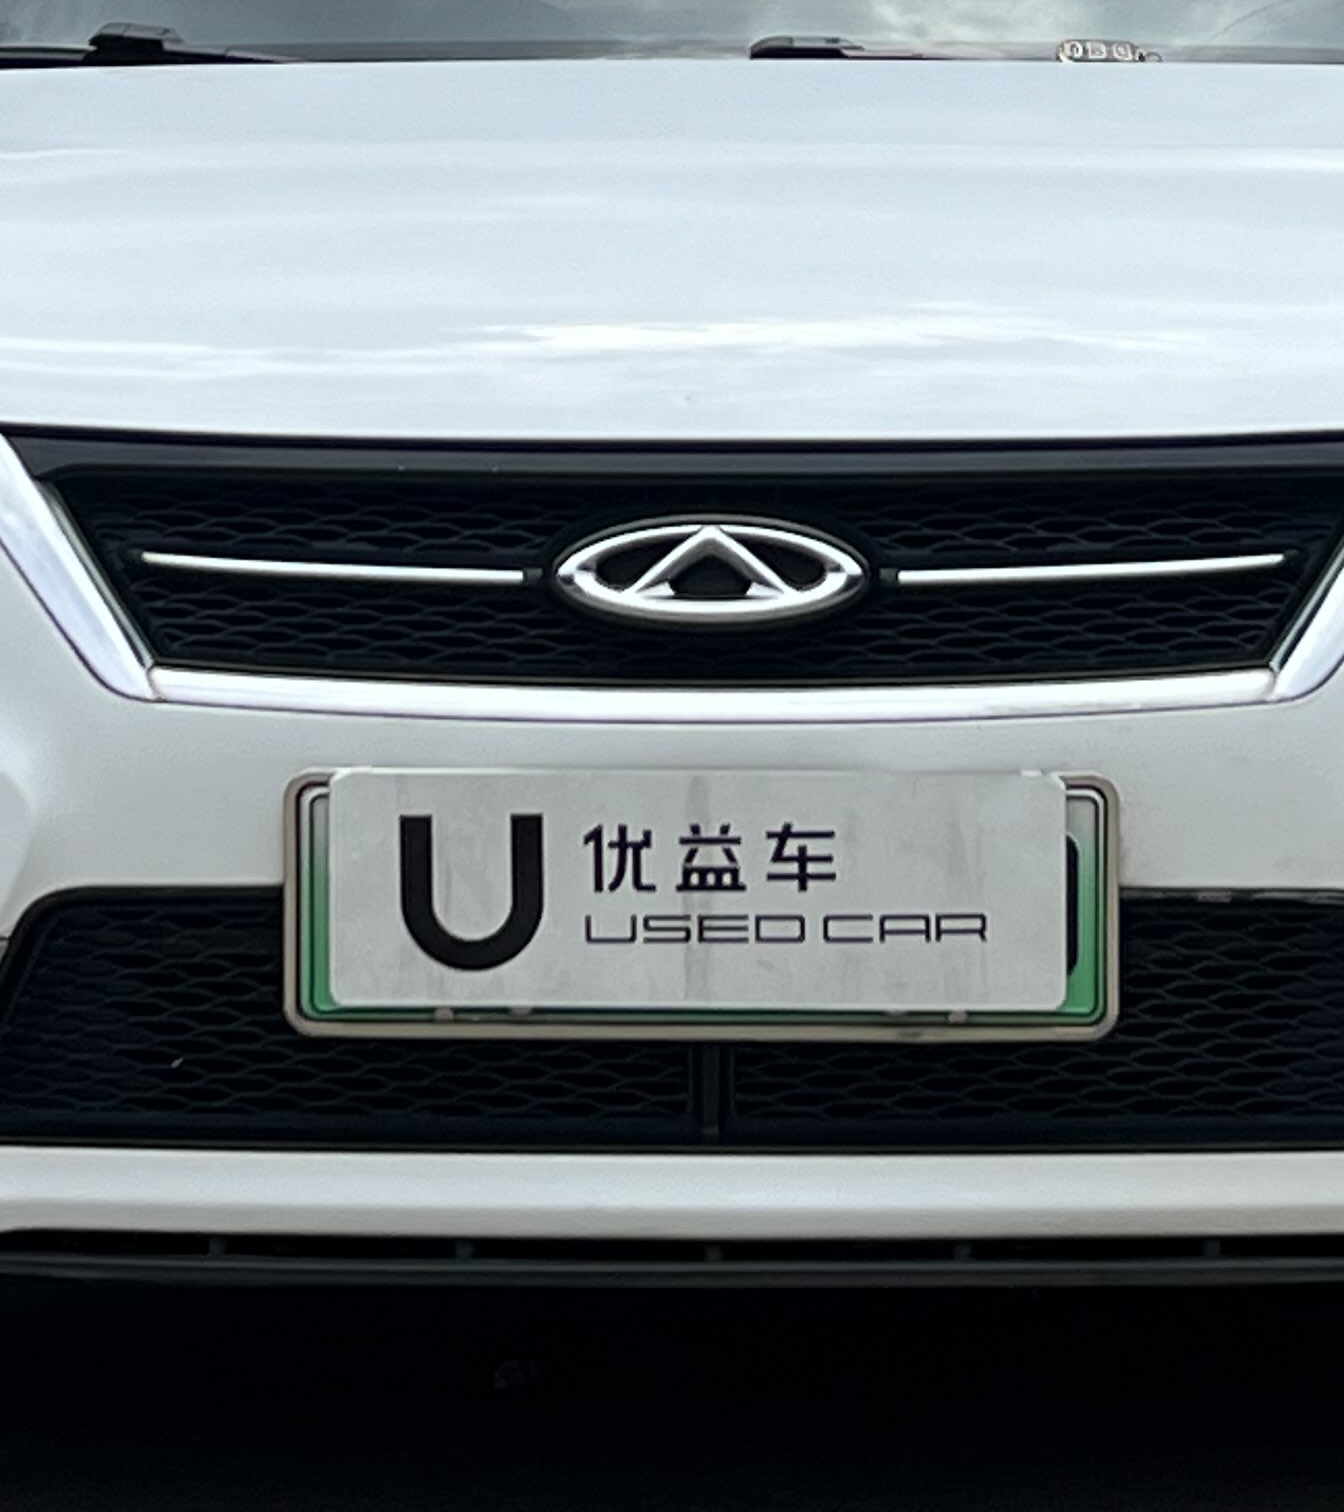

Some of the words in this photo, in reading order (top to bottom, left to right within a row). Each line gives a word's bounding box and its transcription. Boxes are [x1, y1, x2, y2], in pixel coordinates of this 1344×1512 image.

[398, 813, 544, 972] U
[582, 821, 838, 894] 优益车
[584, 913, 806, 945] USED
[822, 913, 987, 944] CAR
